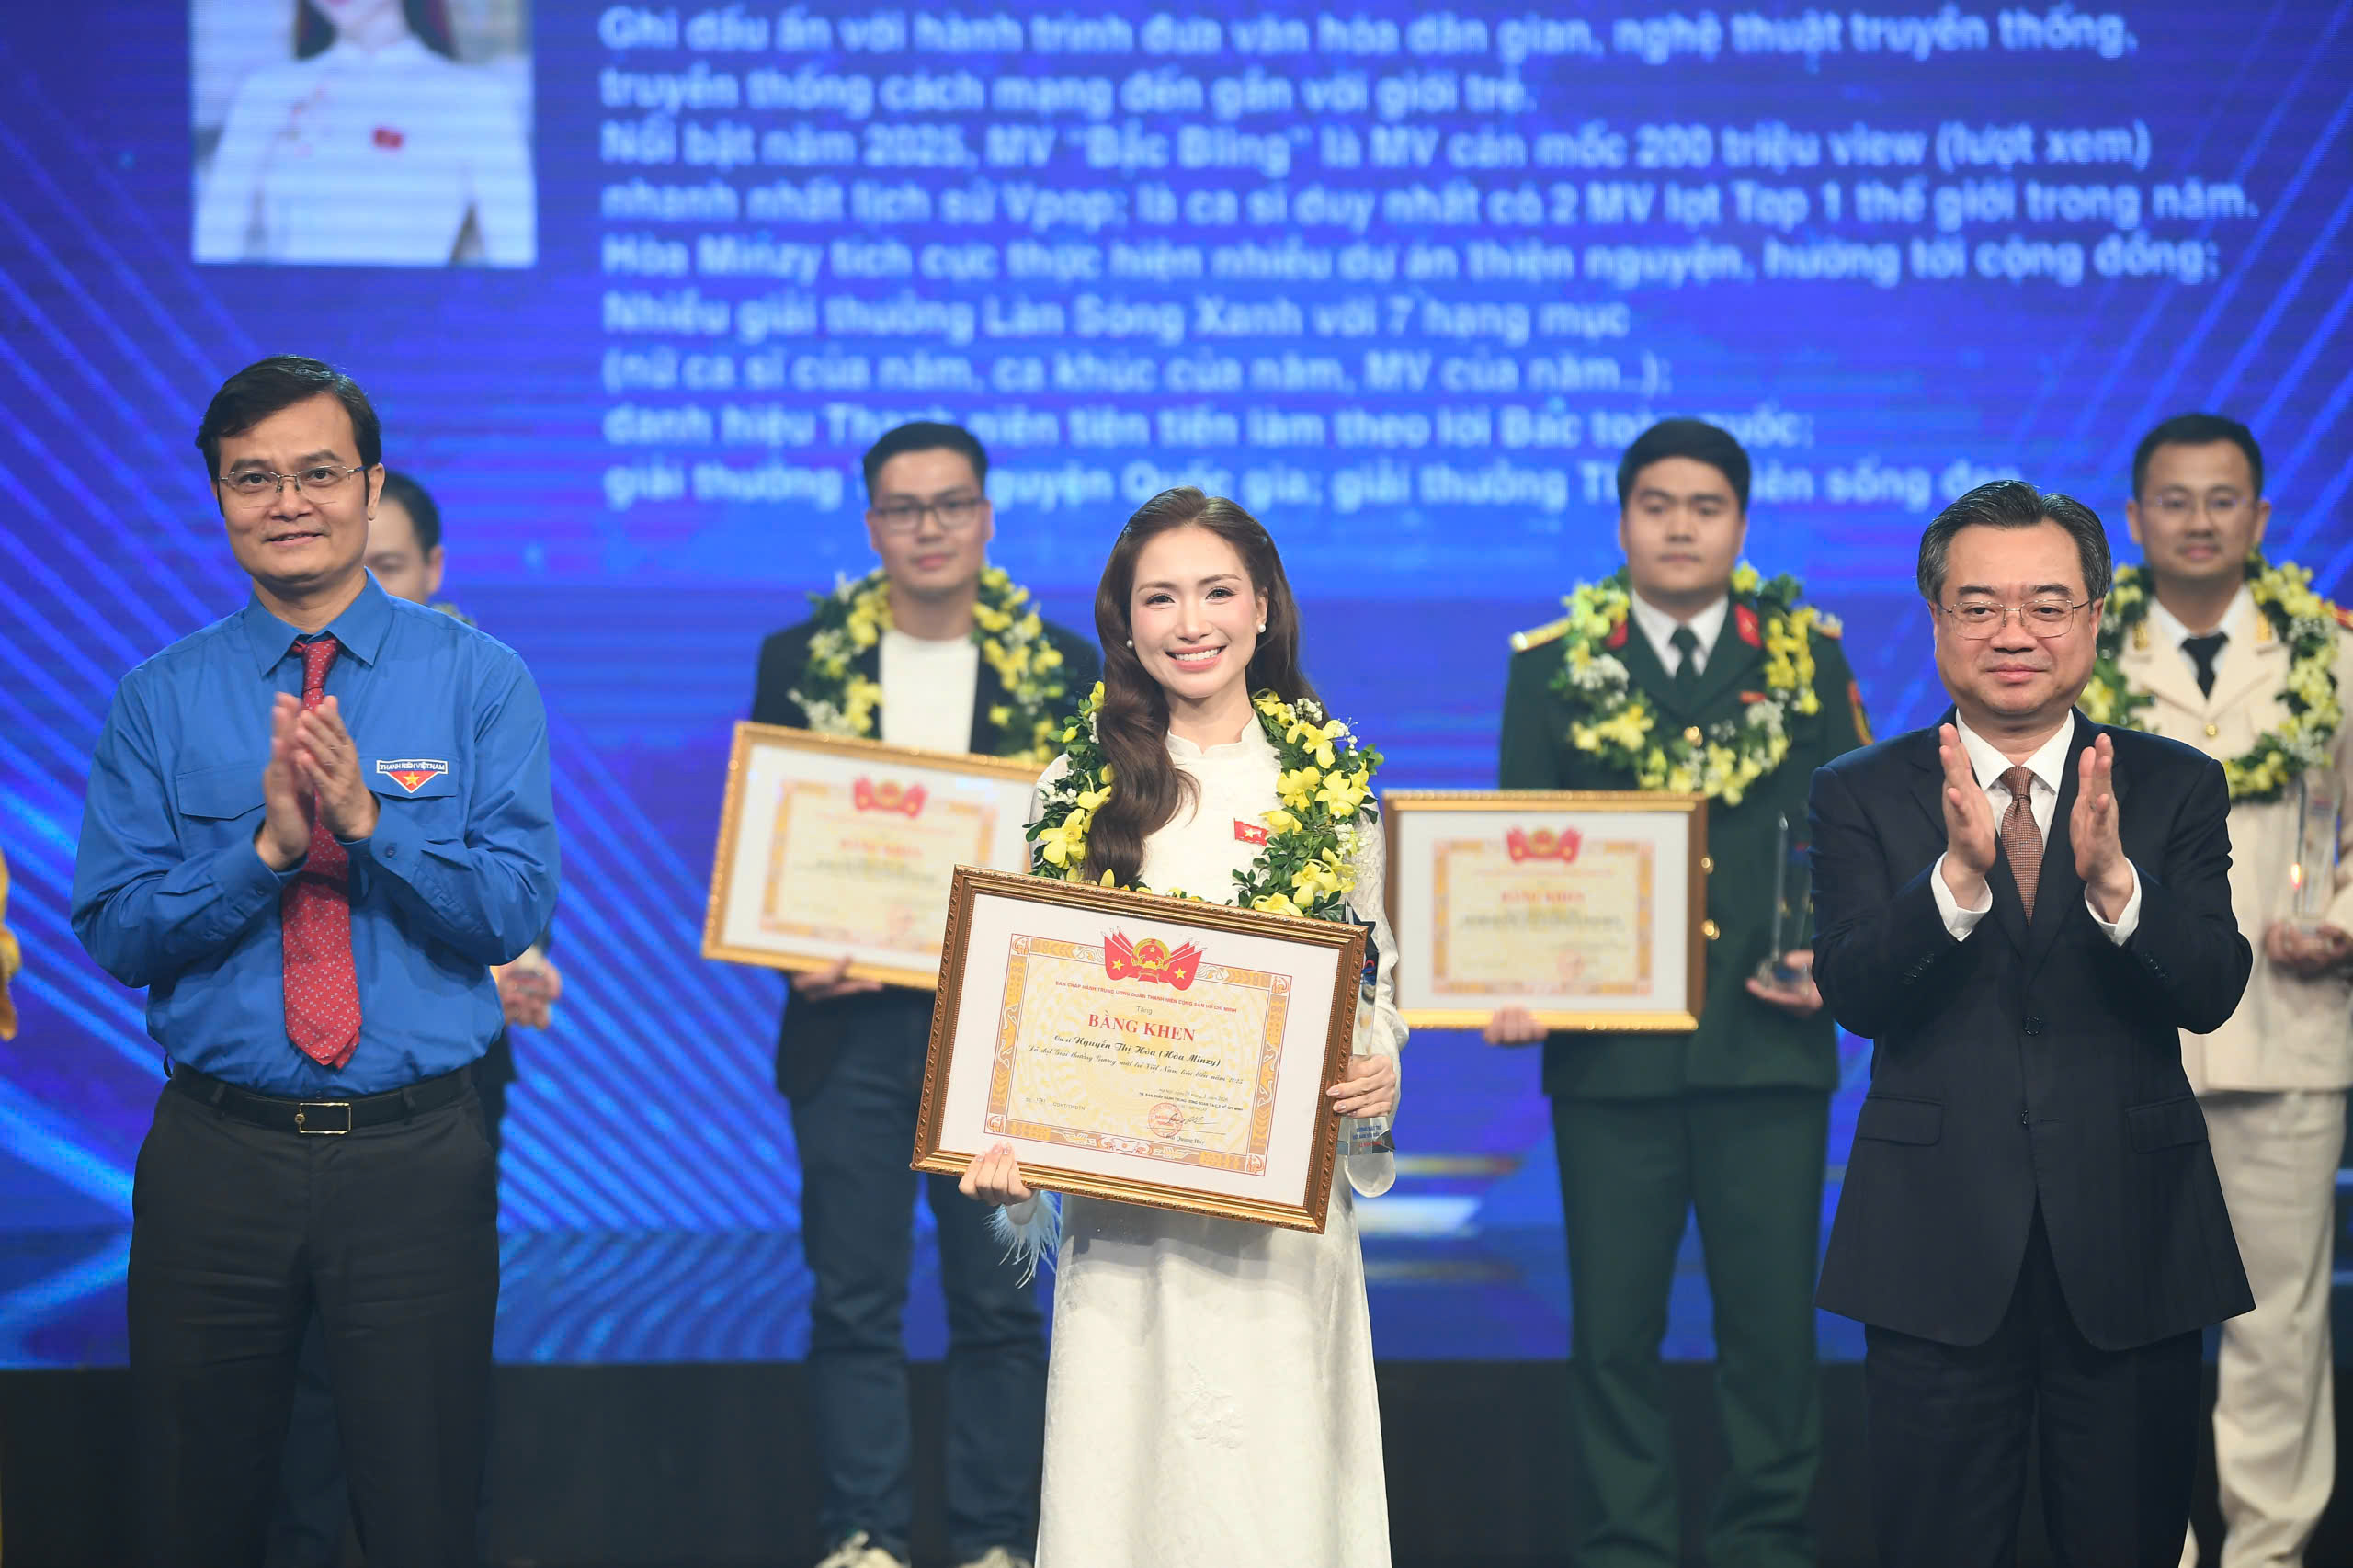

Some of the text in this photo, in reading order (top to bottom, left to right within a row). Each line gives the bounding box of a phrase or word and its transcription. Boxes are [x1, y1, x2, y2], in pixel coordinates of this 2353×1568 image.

[985, 467, 1114, 516] guyện
[1147, 994, 1165, 1002] THANH
[1088, 1010, 1195, 1042] BẰNG KHEN
[1073, 1036, 1111, 1050] Nguyễn
[1114, 1042, 1132, 1054] Thị
[1133, 1045, 1156, 1056] Hòa
[1158, 1050, 1185, 1061] (Hòa
[1186, 1054, 1222, 1067] Minzy)
